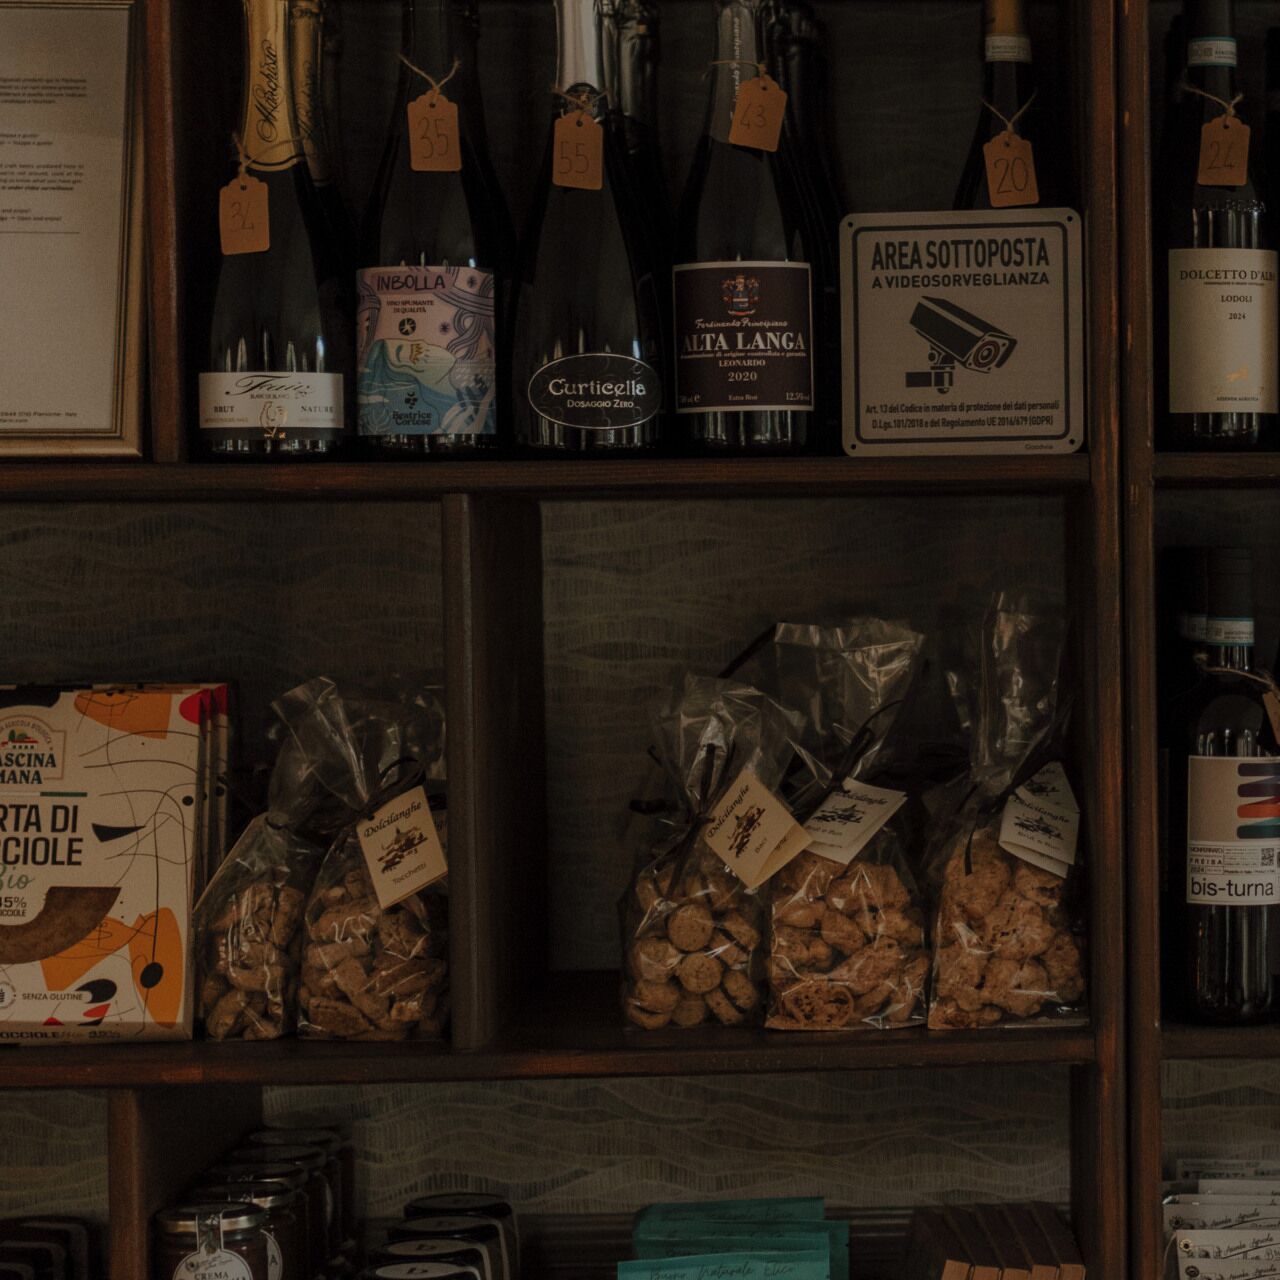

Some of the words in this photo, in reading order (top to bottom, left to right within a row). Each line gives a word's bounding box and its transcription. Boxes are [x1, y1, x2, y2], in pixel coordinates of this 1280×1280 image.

[419, 117, 450, 161] 35
[871, 241, 922, 270] AREA
[926, 237, 1050, 269] SOTTOPOSTA
[376, 274, 446, 291] INBOLLA
[871, 276, 882, 289] A
[885, 271, 1050, 288] VIDEOSORVEGLIANZA
[1179, 269, 1247, 281] DOLCETTO
[1220, 294, 1253, 303] LODOLI
[682, 332, 730, 352] ALTA
[736, 331, 806, 351] LANGA
[718, 359, 767, 368] LEONARDO
[727, 371, 758, 382] 2020
[549, 378, 647, 397] Curticella
[888, 403, 899, 413] del
[901, 402, 922, 413] Codice
[931, 402, 957, 412] materia
[966, 401, 1001, 413] protezione
[1014, 401, 1027, 410] dati
[1028, 400, 1060, 411] personali
[363, 800, 423, 839] Dolcilanghe
[1190, 877, 1275, 897] bis-turna
[22, 992, 48, 1001] SENZA
[50, 992, 84, 1001] GLUTINE
[194, 1271, 229, 1280] CREMA
